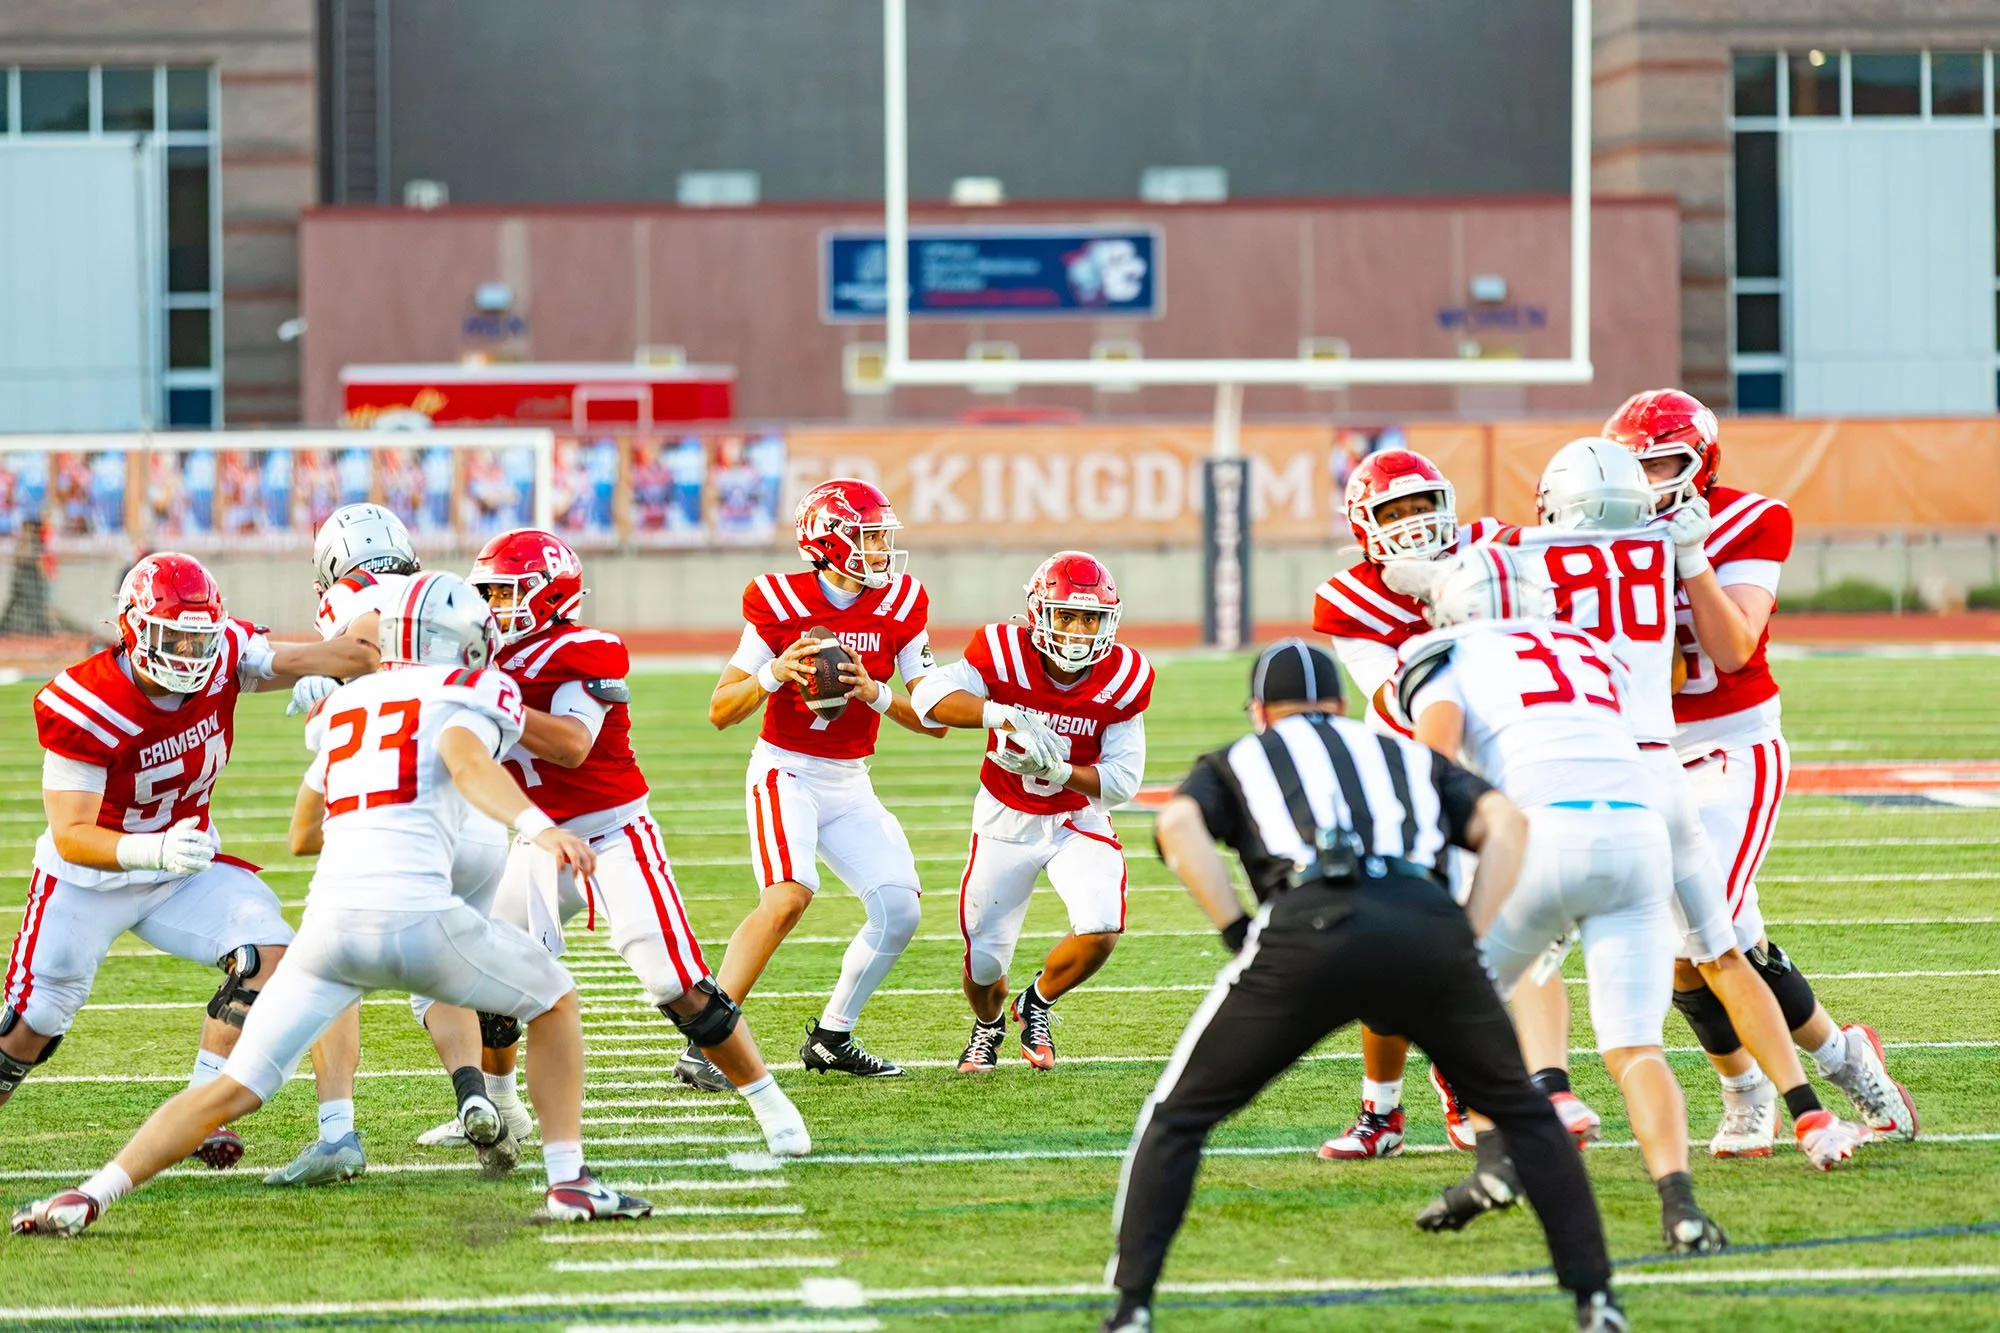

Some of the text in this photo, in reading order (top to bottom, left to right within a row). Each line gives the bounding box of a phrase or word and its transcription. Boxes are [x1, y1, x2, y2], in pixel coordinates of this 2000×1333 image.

[1544, 540, 1665, 643] 88
[1512, 631, 1623, 713] 33
[122, 732, 228, 833] 54
[139, 710, 219, 768] CRIMSON
[323, 697, 422, 818] 23
[811, 1042, 838, 1064] NIKE
